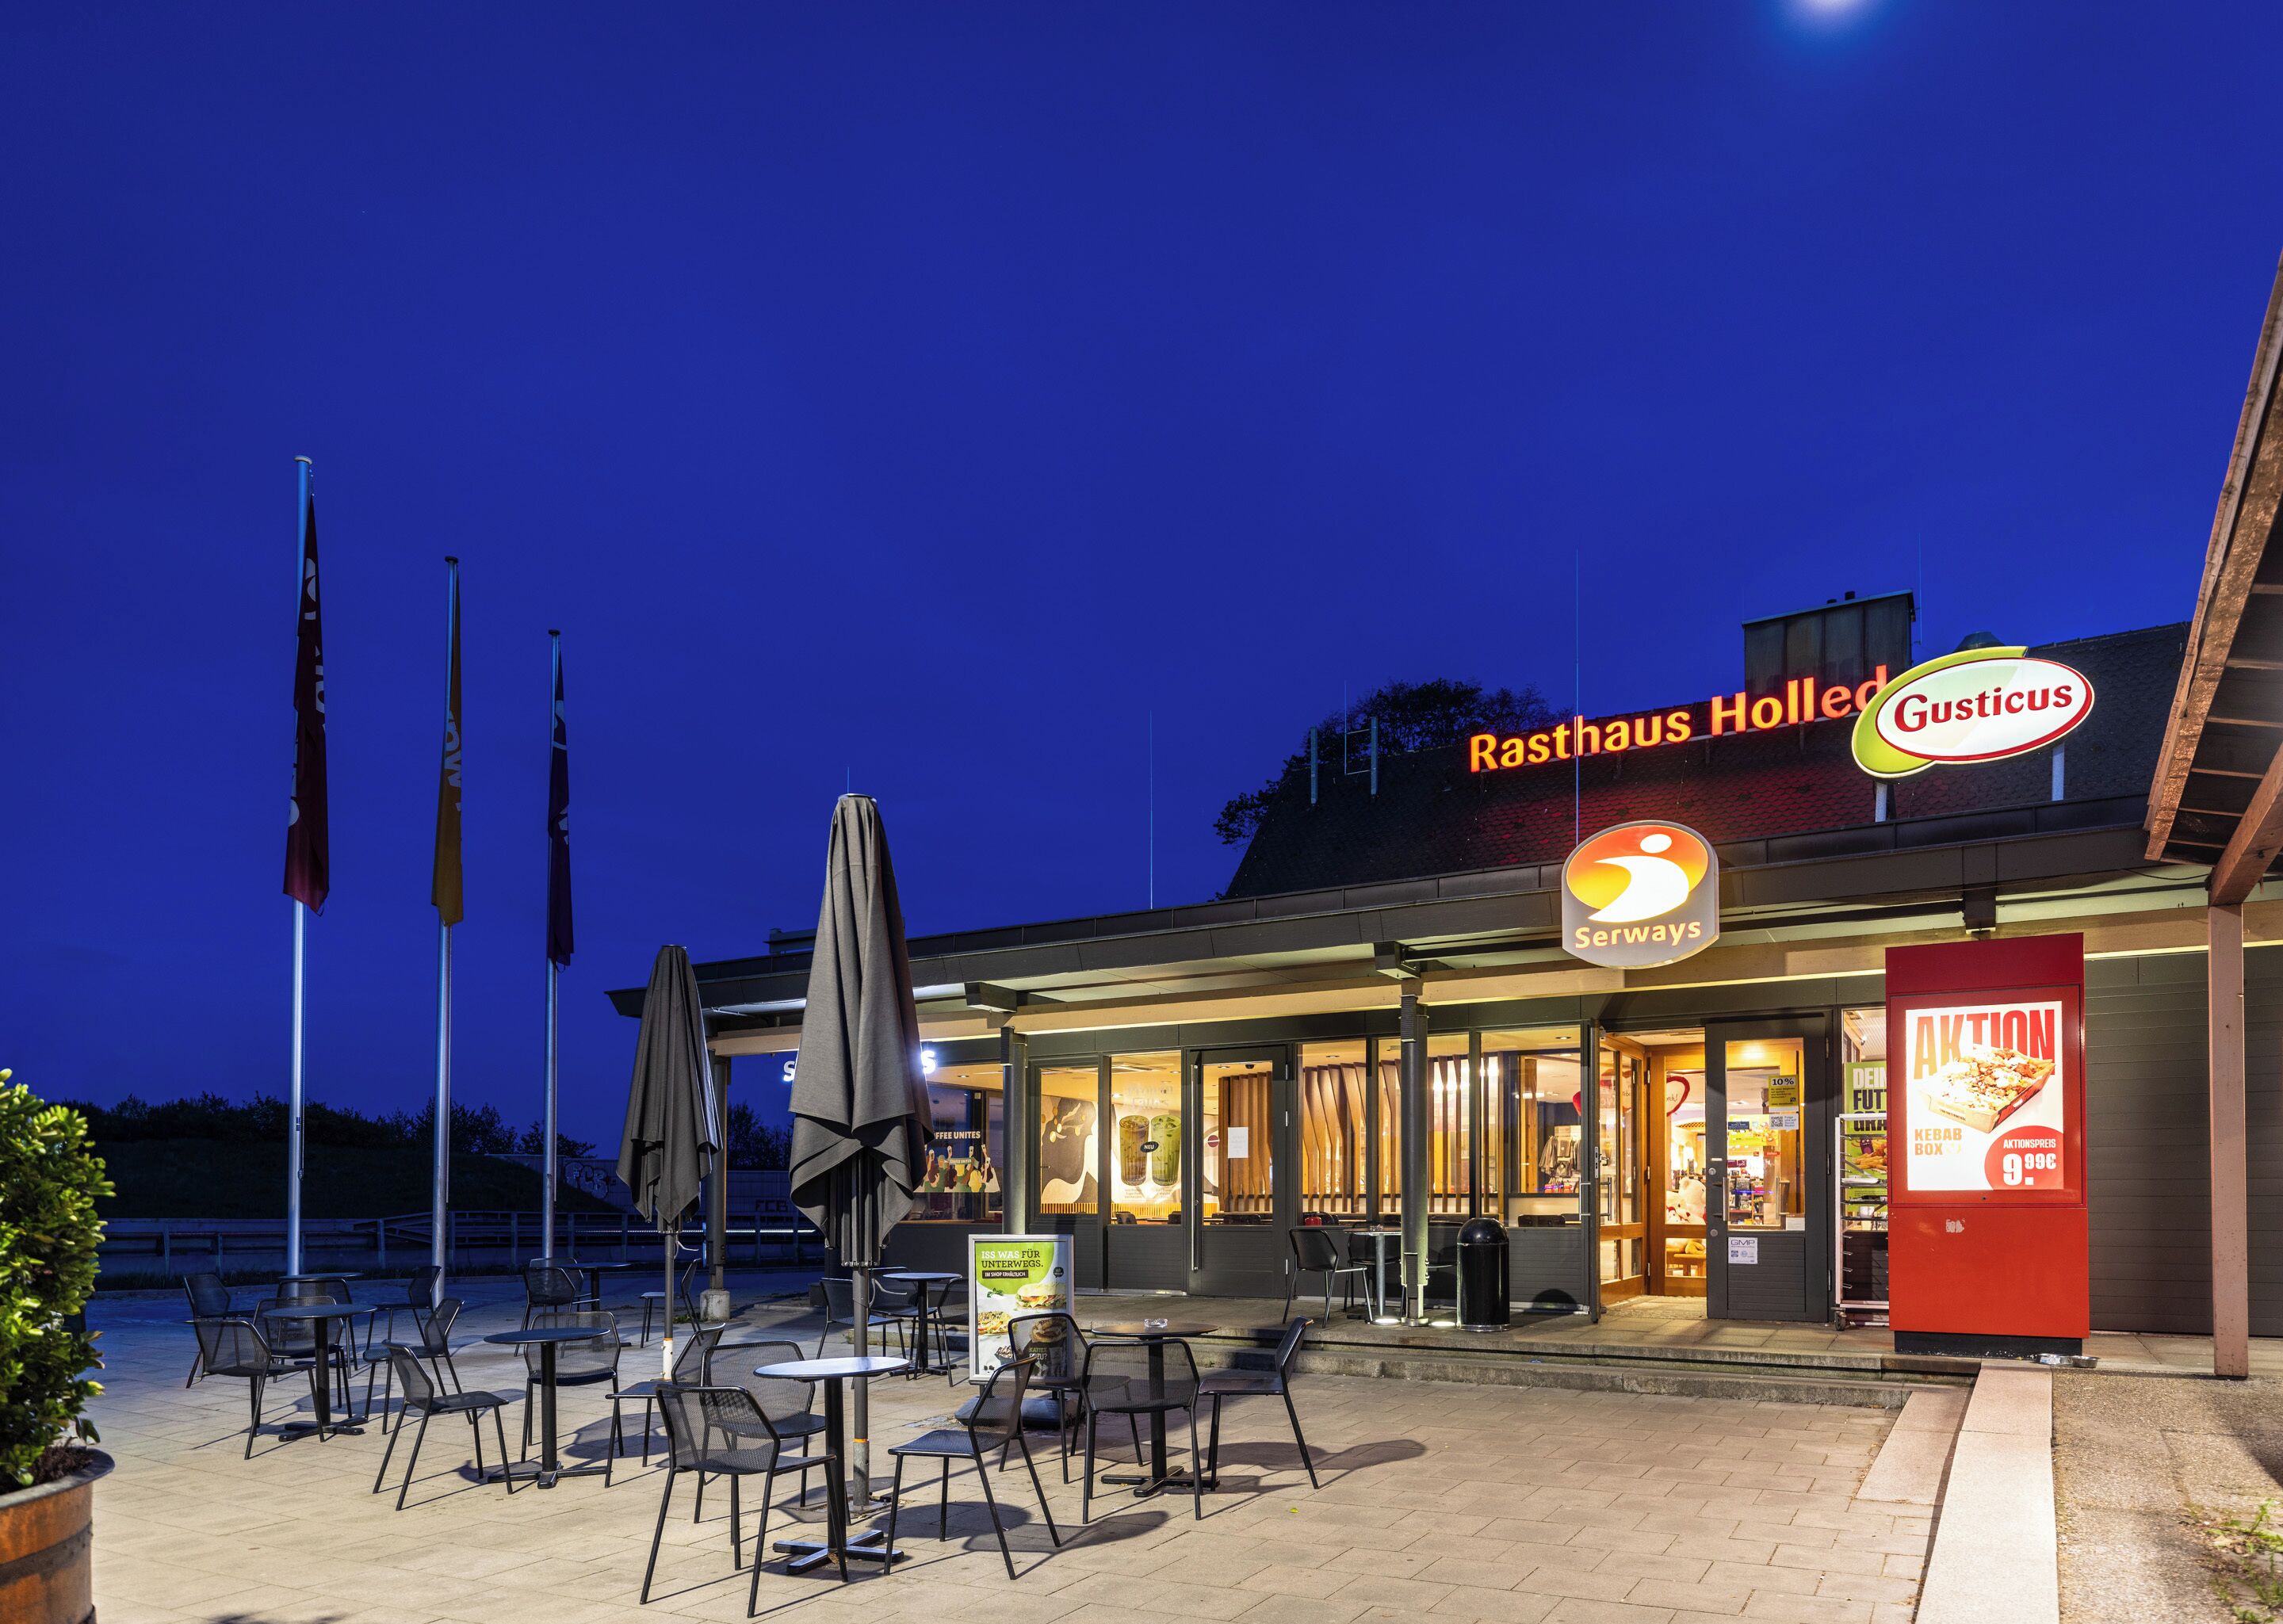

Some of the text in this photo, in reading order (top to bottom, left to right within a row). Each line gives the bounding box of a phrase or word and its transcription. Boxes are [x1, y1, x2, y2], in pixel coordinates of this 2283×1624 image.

[1894, 685, 2072, 732] Gusticus
[1470, 711, 1692, 773] Rasthaus
[1574, 920, 1701, 950] Serways
[1914, 1009, 2055, 1079] AKTION
[1914, 1128, 1962, 1141] KEBAB
[1914, 1143, 1943, 1156] BOX
[2003, 1138, 2056, 1148] AKTIONSPREIS
[1022, 1249, 1040, 1258] FÜR
[981, 1259, 1043, 1268] UNTERWEGS.
